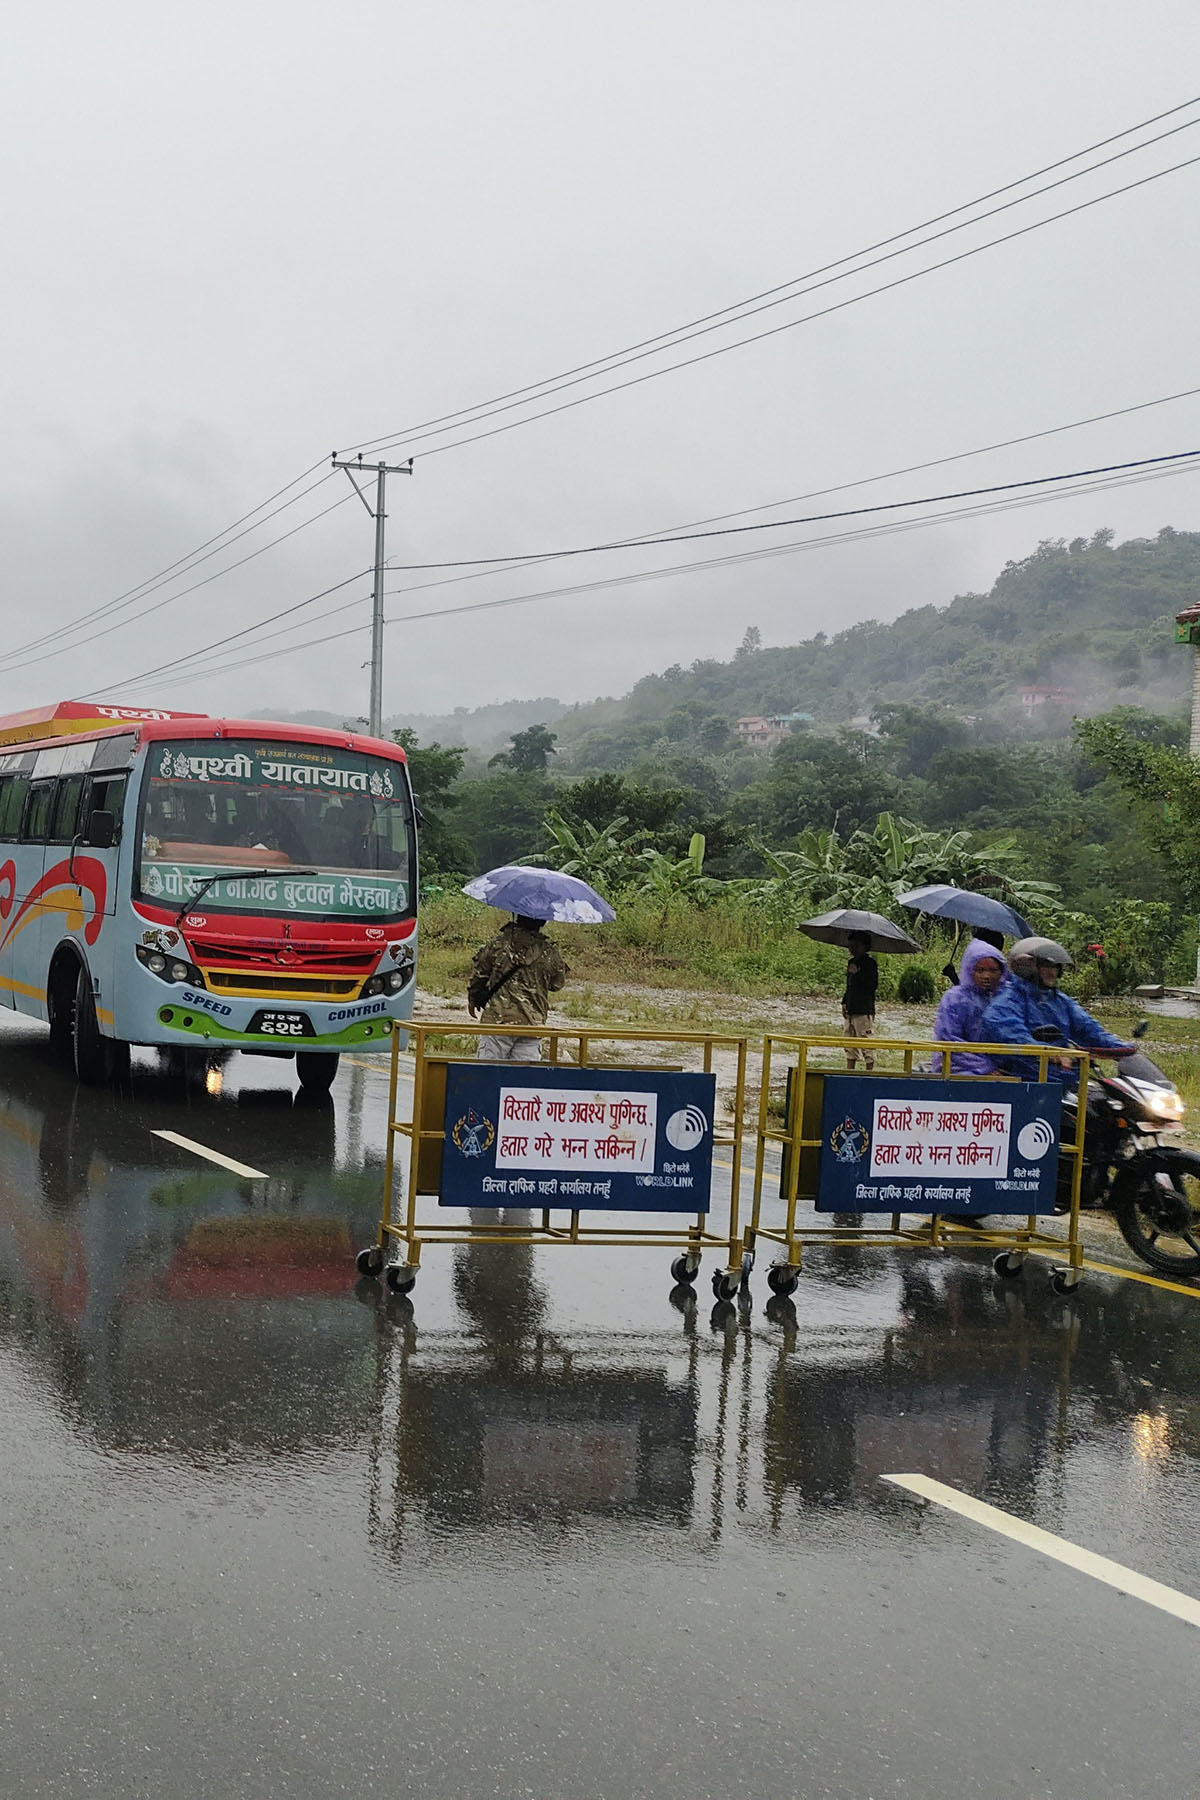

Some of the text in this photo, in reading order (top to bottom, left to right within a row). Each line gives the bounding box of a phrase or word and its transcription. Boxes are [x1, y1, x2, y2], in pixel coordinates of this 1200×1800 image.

[188, 754, 368, 791] पृथ्वी यातायात
[283, 880, 336, 909] बुटवल
[339, 877, 391, 911] भैरहवा
[182, 991, 233, 1016] SPEED
[328, 1001, 387, 1022] CONTROL
[503, 1095, 543, 1121] विस्तारै
[546, 1102, 567, 1123] गए
[569, 1102, 607, 1124] अवश्य
[877, 1105, 913, 1131] विस्तारै
[936, 1111, 968, 1132] अवश्य
[500, 1136, 529, 1158] हतार
[534, 1132, 555, 1158] गरे
[561, 1138, 589, 1159] भन्न
[594, 1135, 637, 1160] सकिन्न
[874, 1144, 901, 1166] हतार
[905, 1141, 924, 1165] गरे
[928, 1146, 952, 1165] भन्न
[956, 1142, 994, 1165] सकिन्न
[482, 1176, 508, 1193] जिल्ला
[508, 1177, 536, 1196] ट्राफिक
[538, 1178, 558, 1195] प्रहरी
[559, 1178, 592, 1195] कार्यालय
[856, 1183, 878, 1198] जिल्ला
[879, 1184, 902, 1201] ट्राफिक
[903, 1184, 923, 1201] प्रहरी
[924, 1184, 954, 1200] कार्यालय
